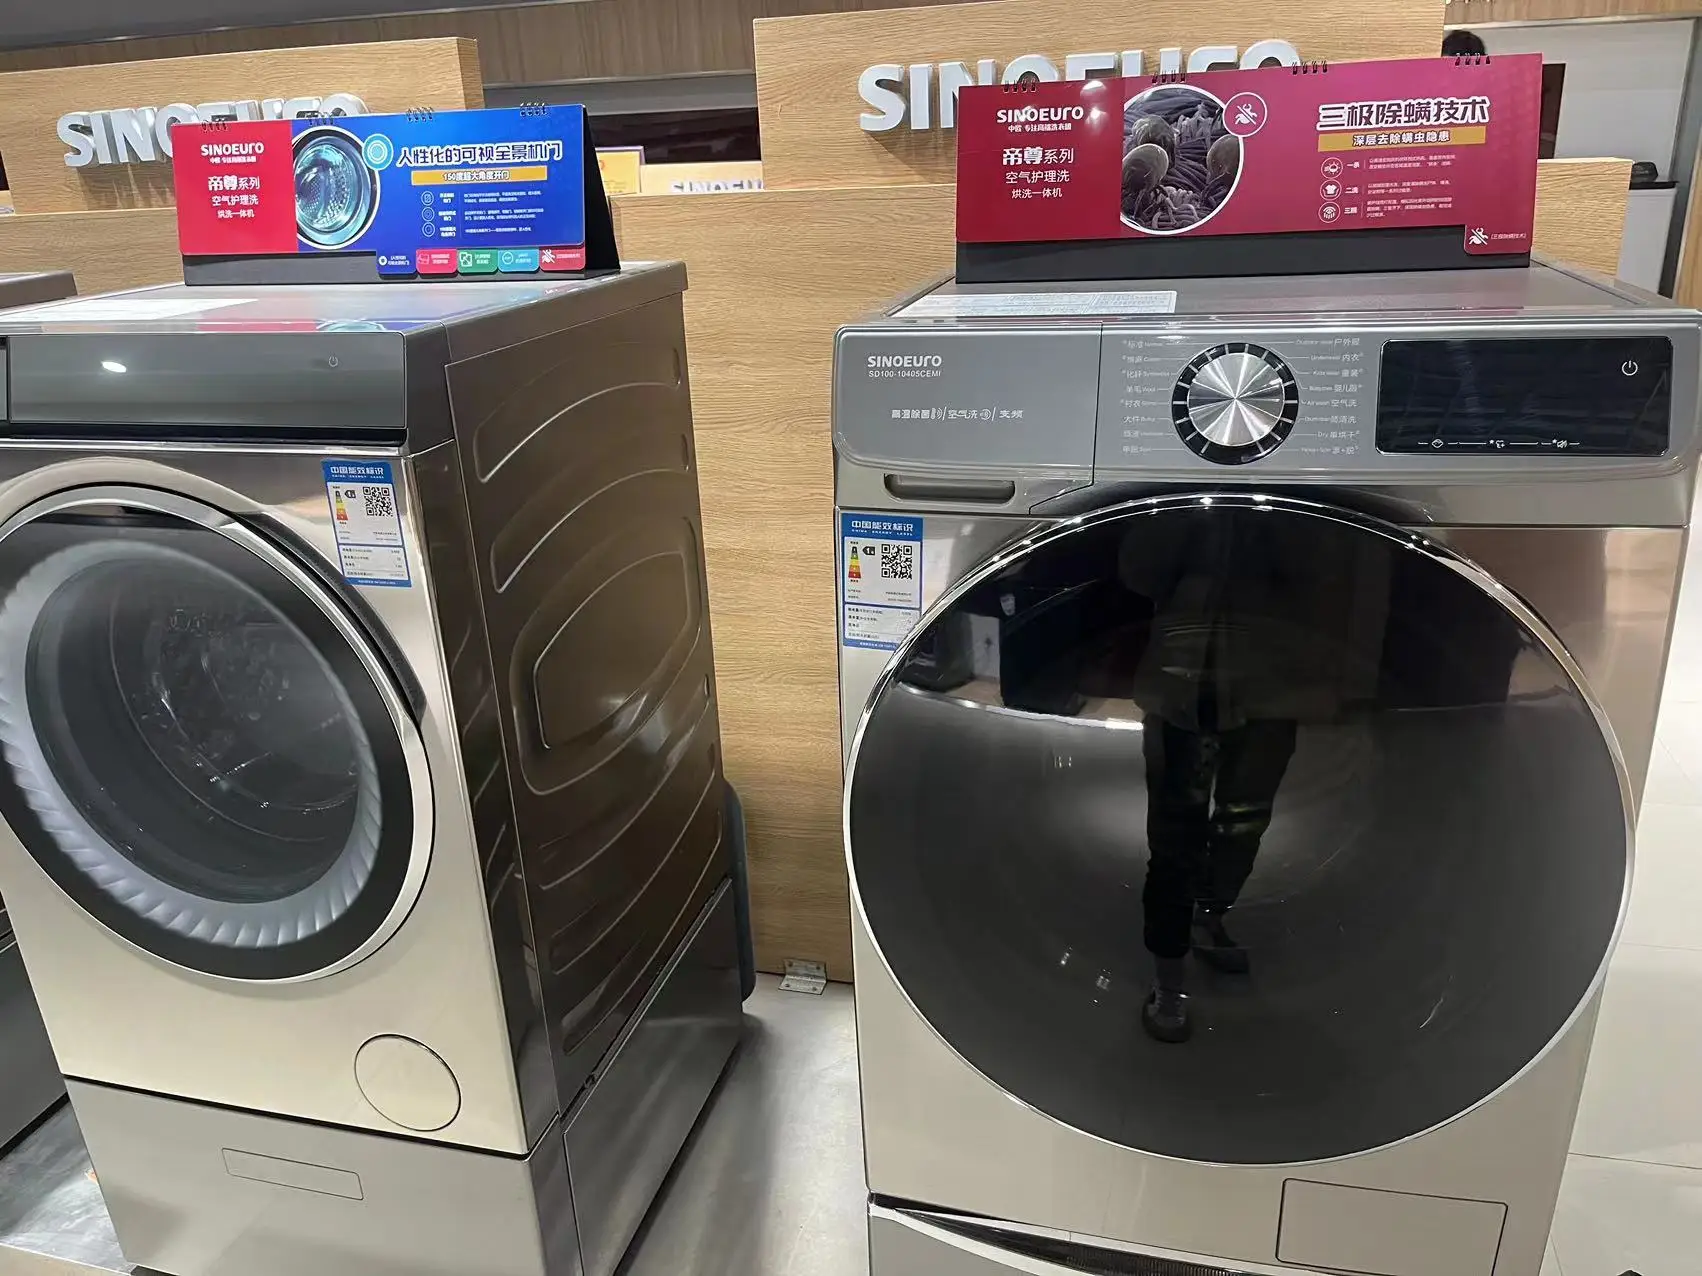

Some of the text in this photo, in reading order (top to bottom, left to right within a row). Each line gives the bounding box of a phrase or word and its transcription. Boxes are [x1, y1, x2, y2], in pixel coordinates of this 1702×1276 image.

[1317, 96, 1489, 130] 三极除螨技术
[1353, 131, 1450, 147] 深层去除螨虫隐患
[396, 141, 562, 167] 人性化的可视全景机门
[1002, 147, 1074, 166] 帝尊系列
[208, 175, 260, 191] 帝尊系列
[1006, 169, 1070, 184] 空气护理洗
[1011, 187, 1063, 199] 烘洗一体机
[211, 194, 259, 206] 空气护理洗
[217, 208, 255, 219] 烘洗一体机
[868, 369, 941, 378] SD100-10405CEMI
[947, 408, 978, 420] 空气洗
[999, 409, 1024, 419] 变频
[851, 520, 914, 532] 中国能效标识
